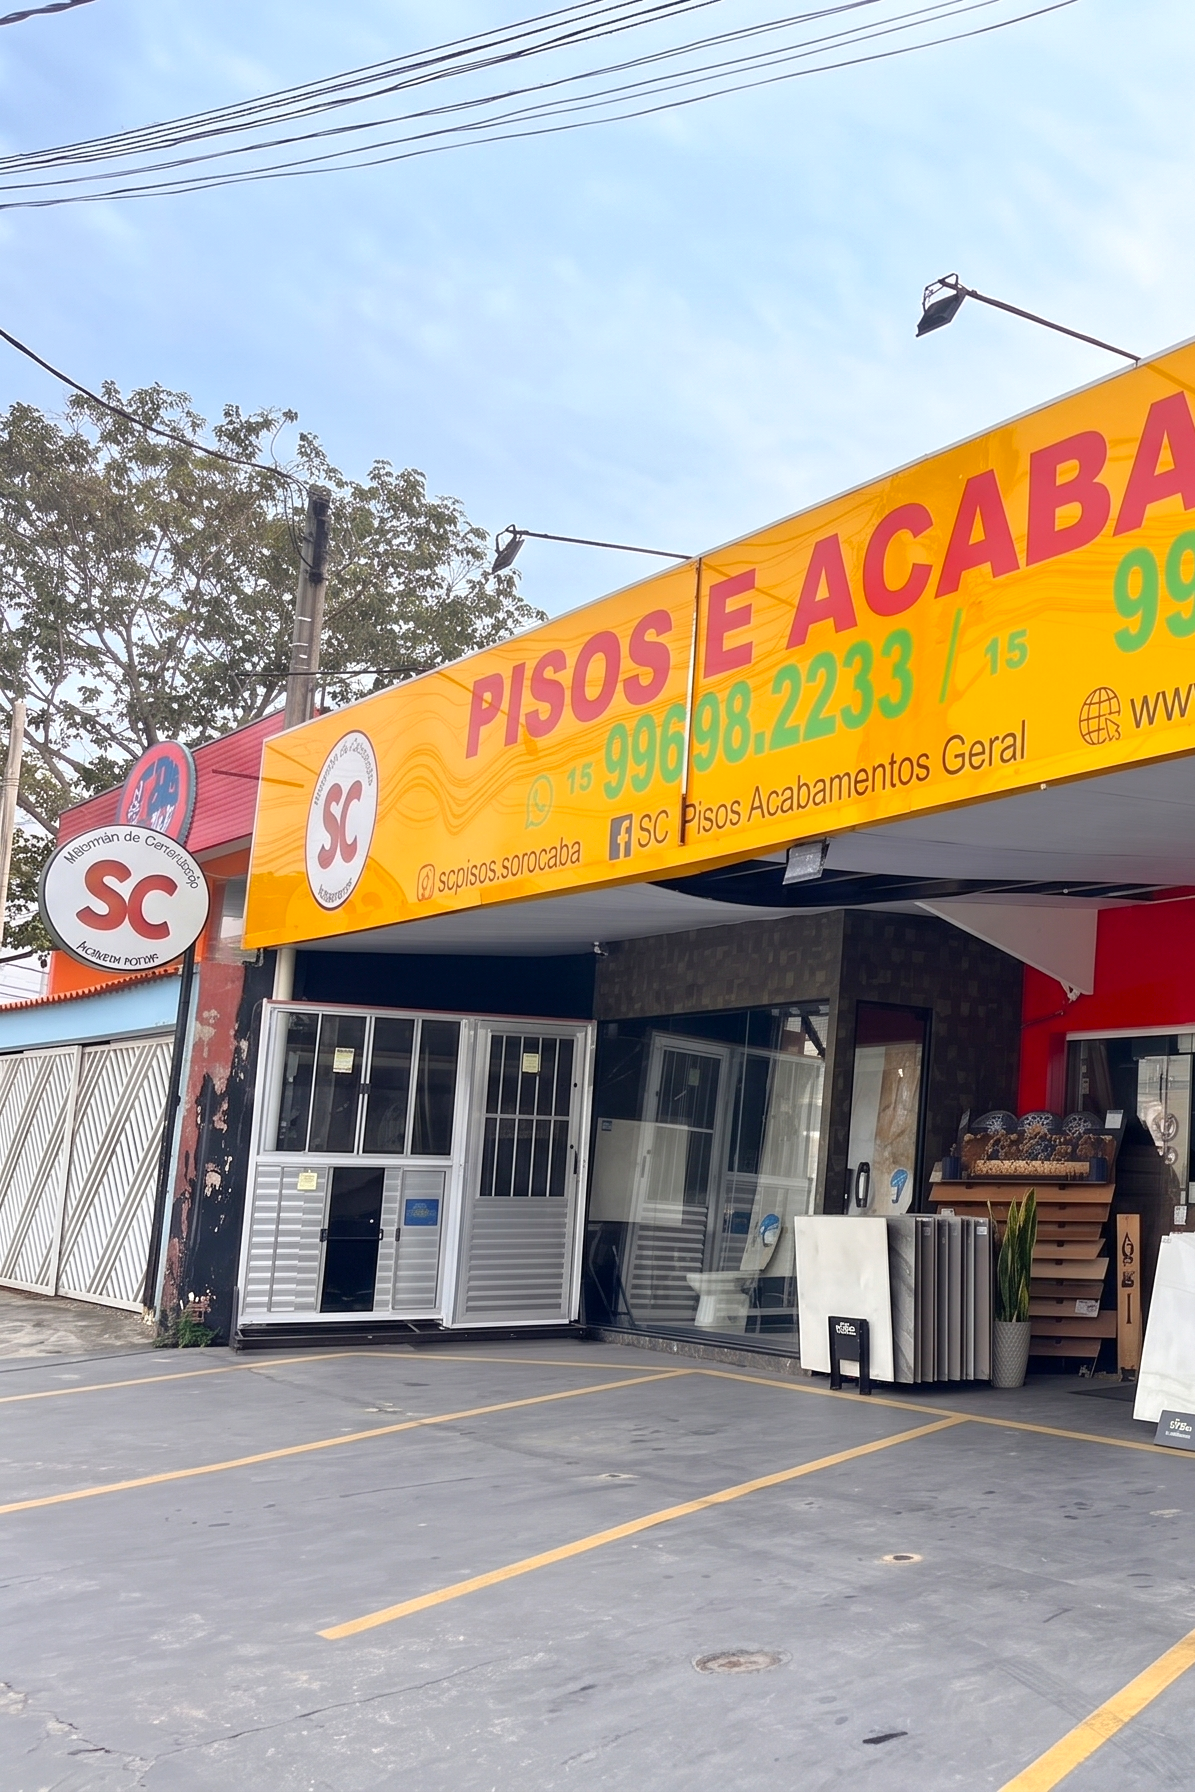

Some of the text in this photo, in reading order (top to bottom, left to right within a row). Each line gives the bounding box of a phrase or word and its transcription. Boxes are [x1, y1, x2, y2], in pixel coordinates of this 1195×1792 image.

[465, 609, 673, 759] PISOS
[703, 567, 757, 679] E
[567, 761, 593, 795] 15
[604, 629, 914, 800] 99698.2233
[984, 630, 1028, 676] 15
[317, 779, 363, 870] SC
[637, 719, 1027, 848] SC Pisos Acabamentos Geral
[124, 831, 141, 843] de
[437, 837, 581, 895] scpisos.sorocaba
[75, 859, 179, 941] SC
